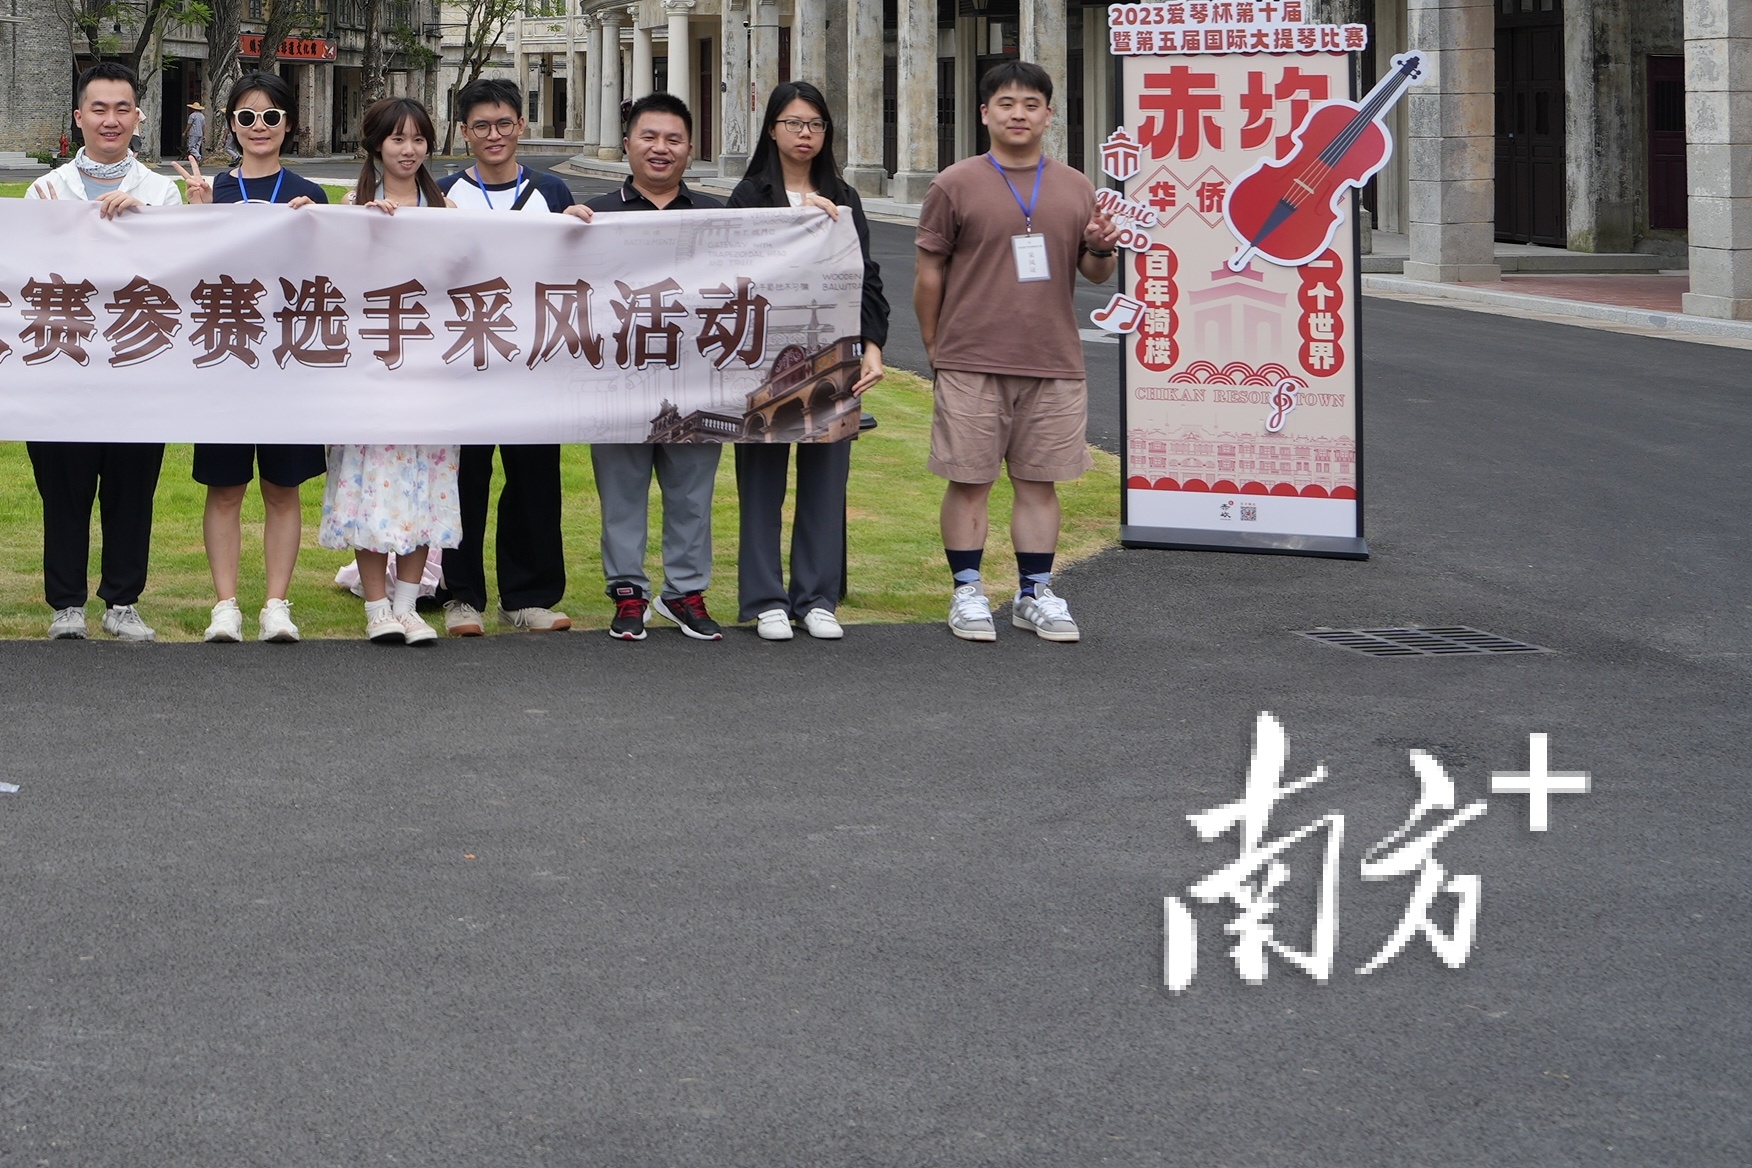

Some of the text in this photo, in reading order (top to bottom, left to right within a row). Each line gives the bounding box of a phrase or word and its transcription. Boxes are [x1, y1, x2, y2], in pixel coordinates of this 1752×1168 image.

[1111, 1, 1302, 25] 2023爱琴杯第十届
[1113, 27, 1365, 52] 暨第五届国际大提琴比赛
[1138, 65, 1330, 161] 赤坎
[1097, 191, 1154, 224] Music
[1149, 181, 1225, 213] 华侨
[1117, 229, 1148, 249] OD
[822, 273, 862, 281] WOODEN
[1144, 250, 1171, 365] 百年骑楼
[1307, 260, 1335, 370] 一个世界
[1134, 387, 1345, 407] CHIKAN RESOR TOWN
